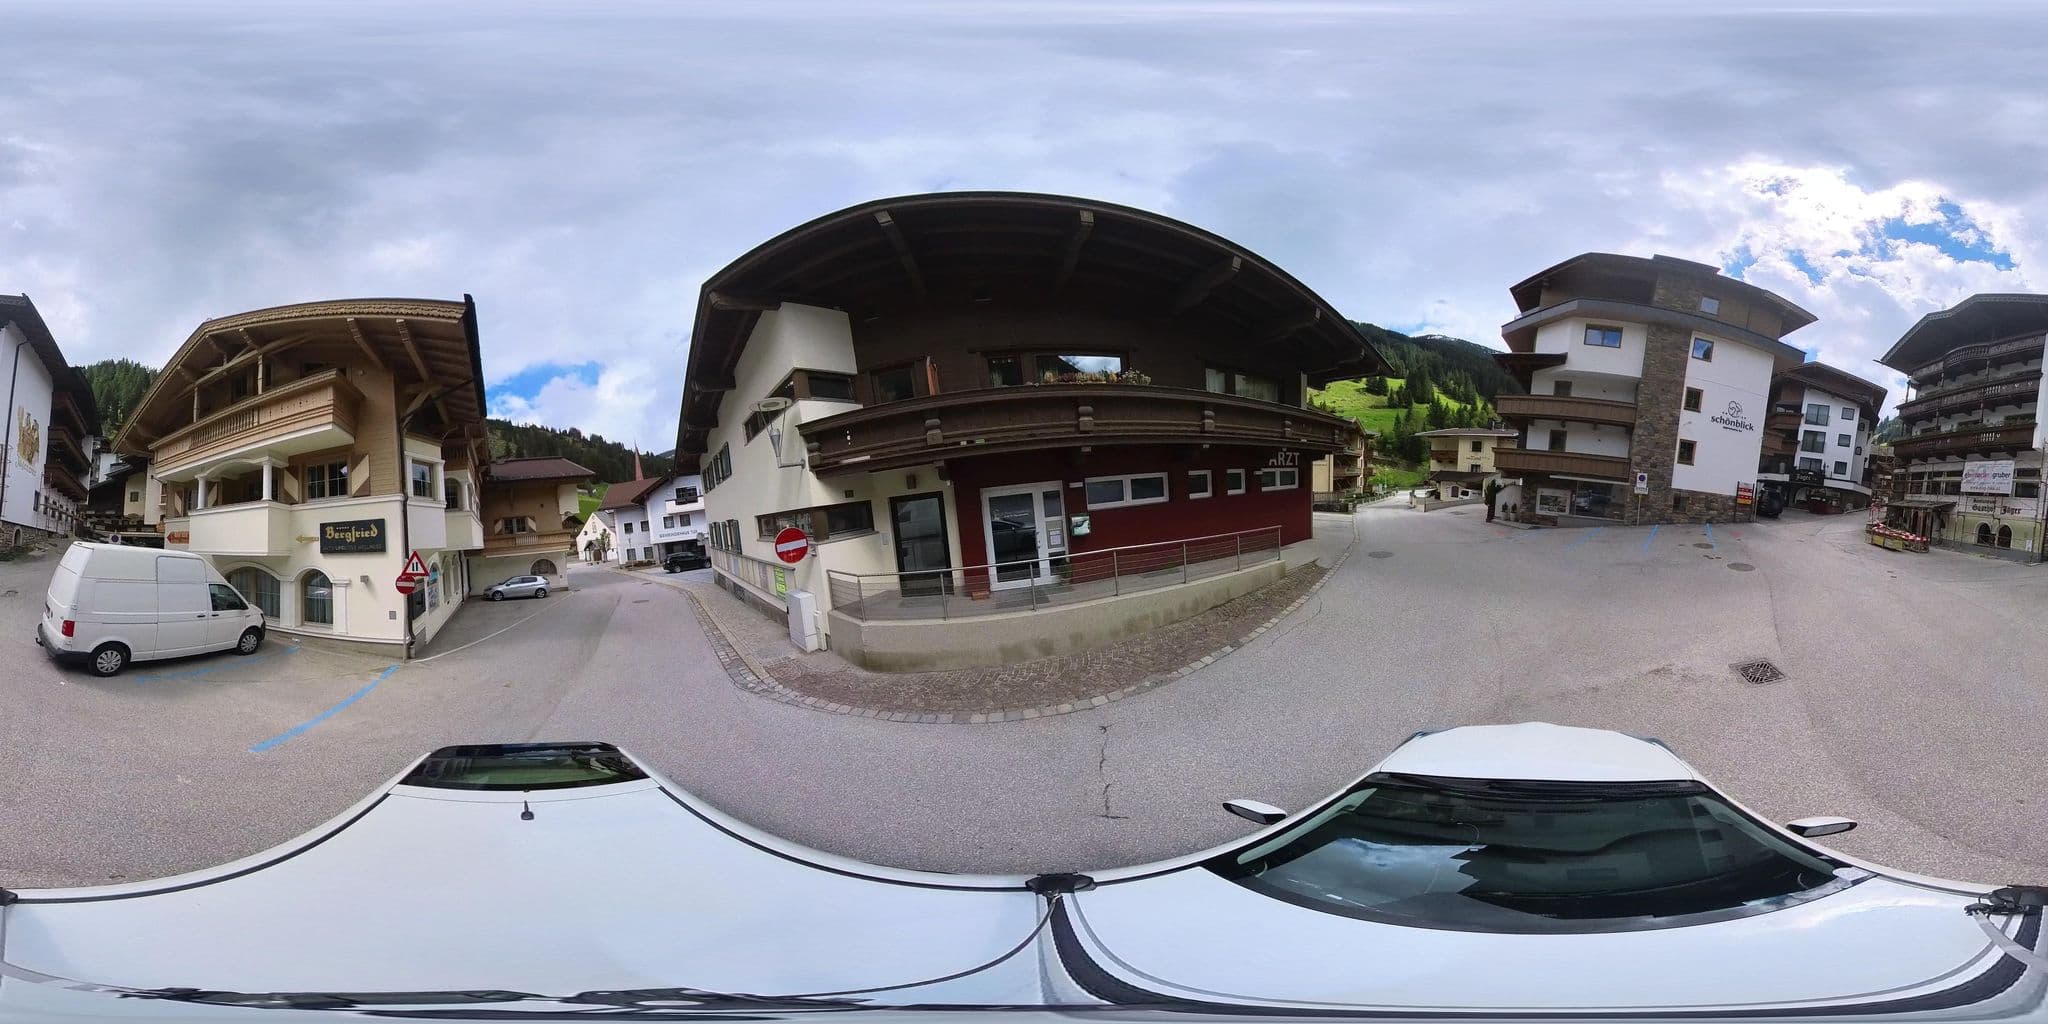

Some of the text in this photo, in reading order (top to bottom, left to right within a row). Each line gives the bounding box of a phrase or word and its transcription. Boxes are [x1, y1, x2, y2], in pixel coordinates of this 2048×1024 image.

[1711, 416, 1754, 431] schönblick
[1269, 453, 1300, 466] ARZT
[325, 524, 378, 542] Bergfried
